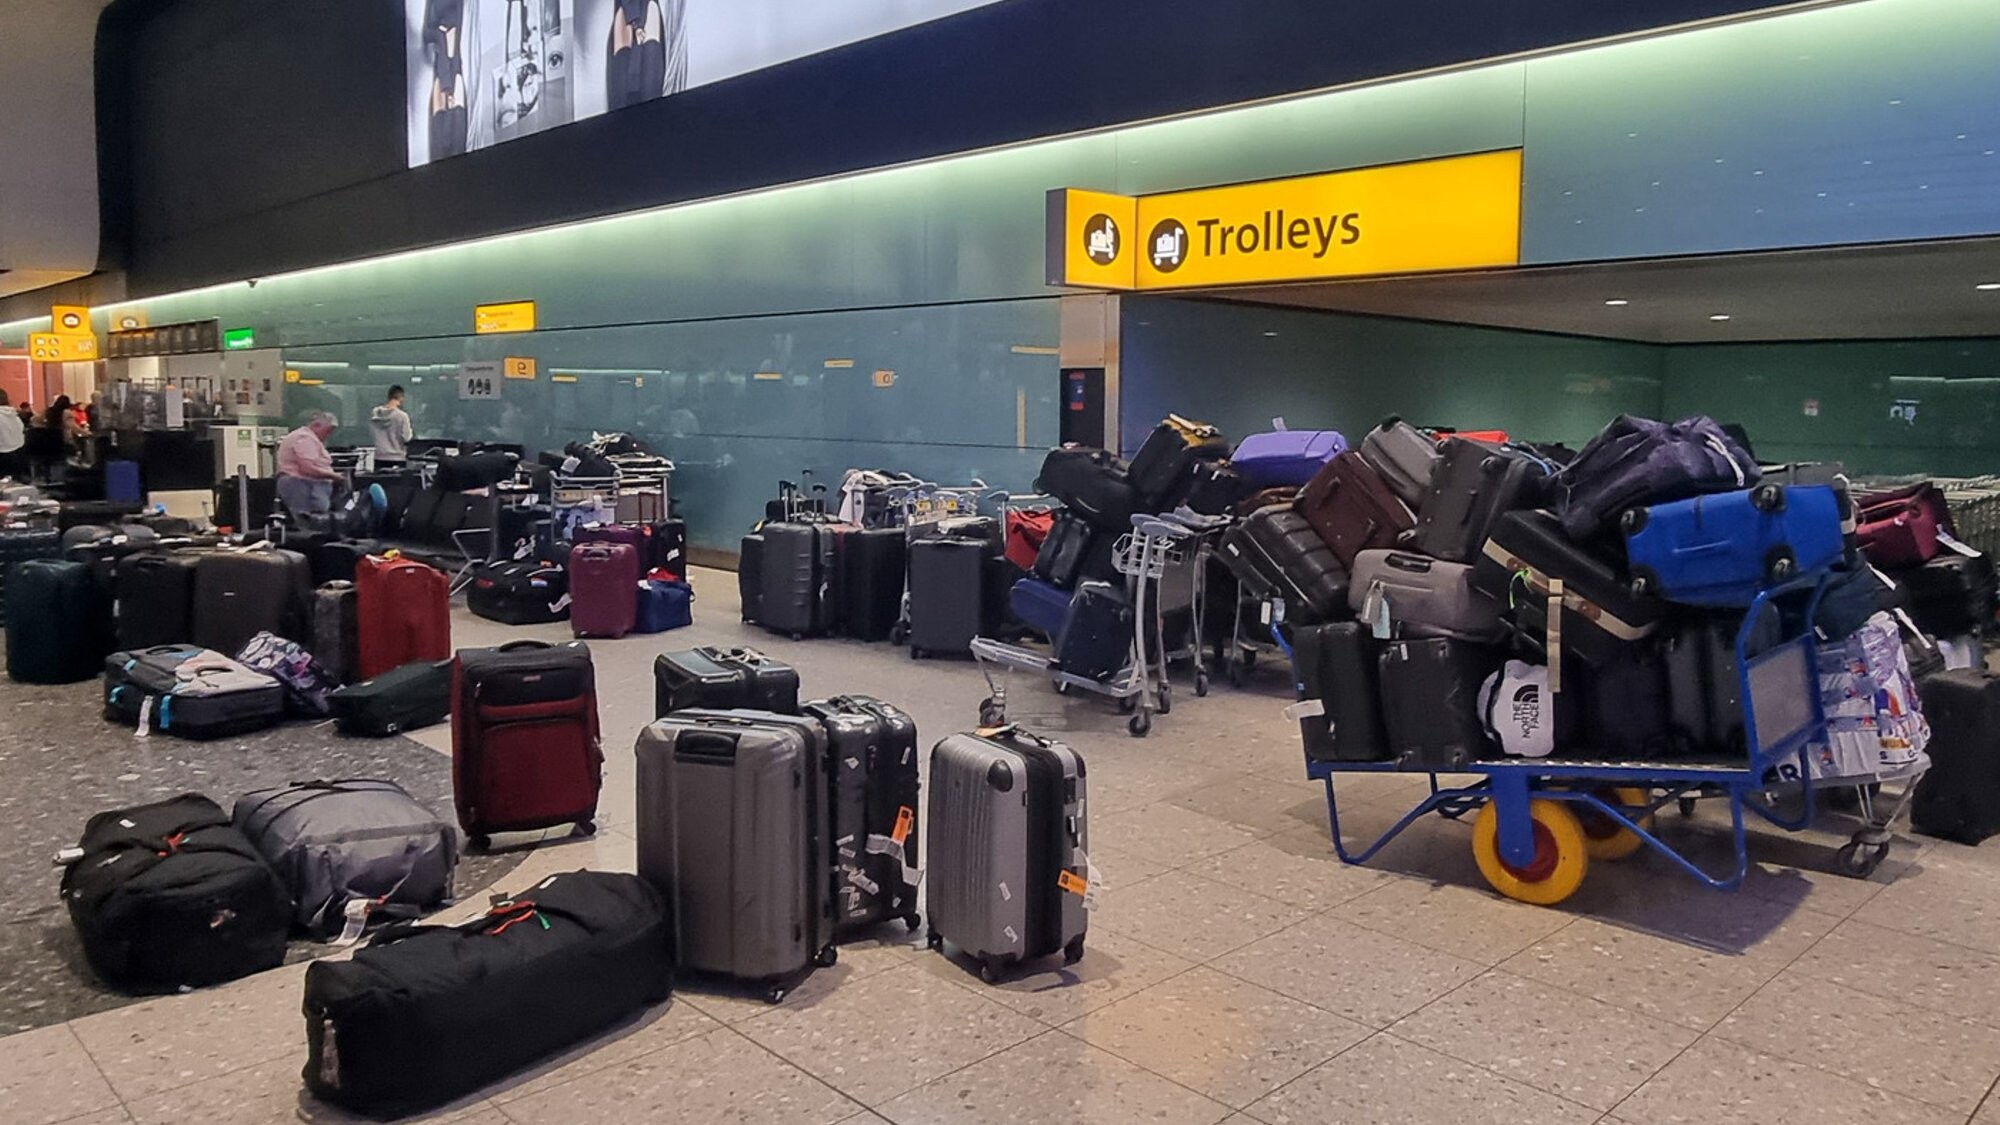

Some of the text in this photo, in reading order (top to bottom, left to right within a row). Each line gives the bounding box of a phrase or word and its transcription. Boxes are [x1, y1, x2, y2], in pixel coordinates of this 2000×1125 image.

[1196, 209, 1361, 259] Trolleys
[1512, 703, 1521, 721] THE
[1520, 703, 1532, 739] NORTH
[1530, 703, 1540, 729] FACE
